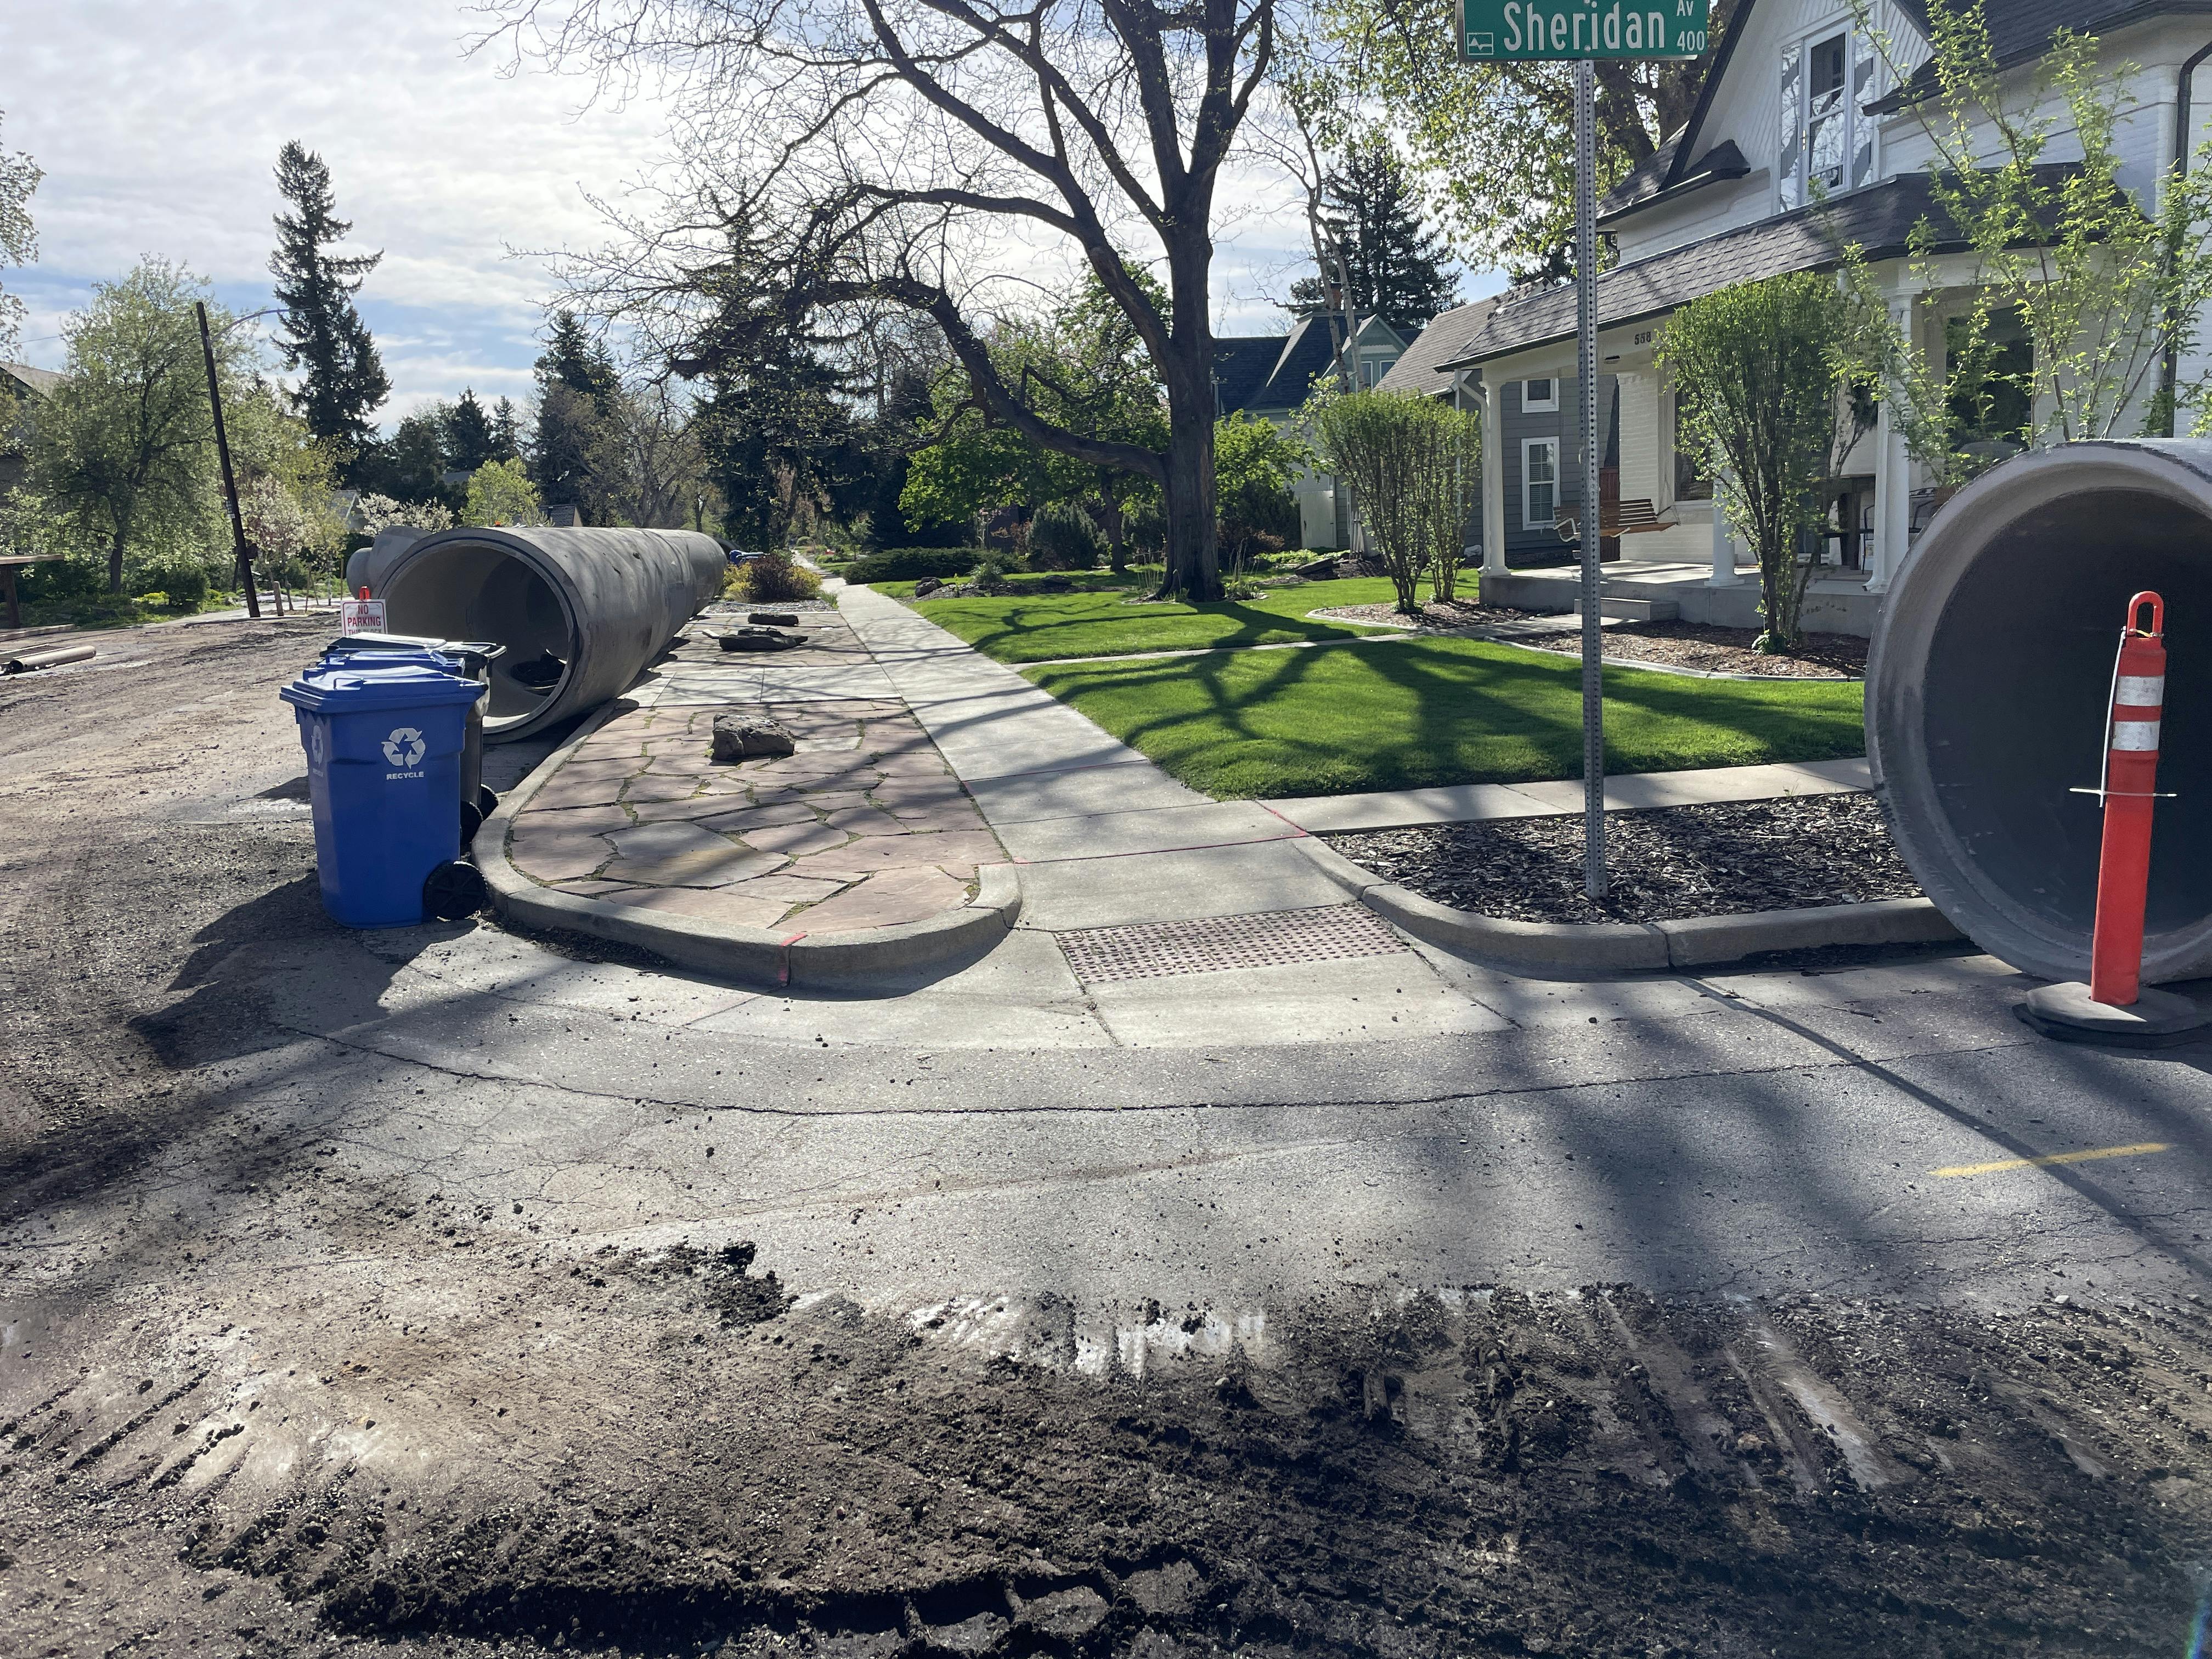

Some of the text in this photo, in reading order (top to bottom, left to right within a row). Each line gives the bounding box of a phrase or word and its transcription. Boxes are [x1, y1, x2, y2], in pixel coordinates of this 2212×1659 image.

[1503, 0, 1694, 52] Sheridan Av
[1677, 31, 1705, 52] 400
[358, 605, 369, 614] NO
[347, 617, 381, 627] PARKING
[386, 771, 424, 780] RECYCLE
